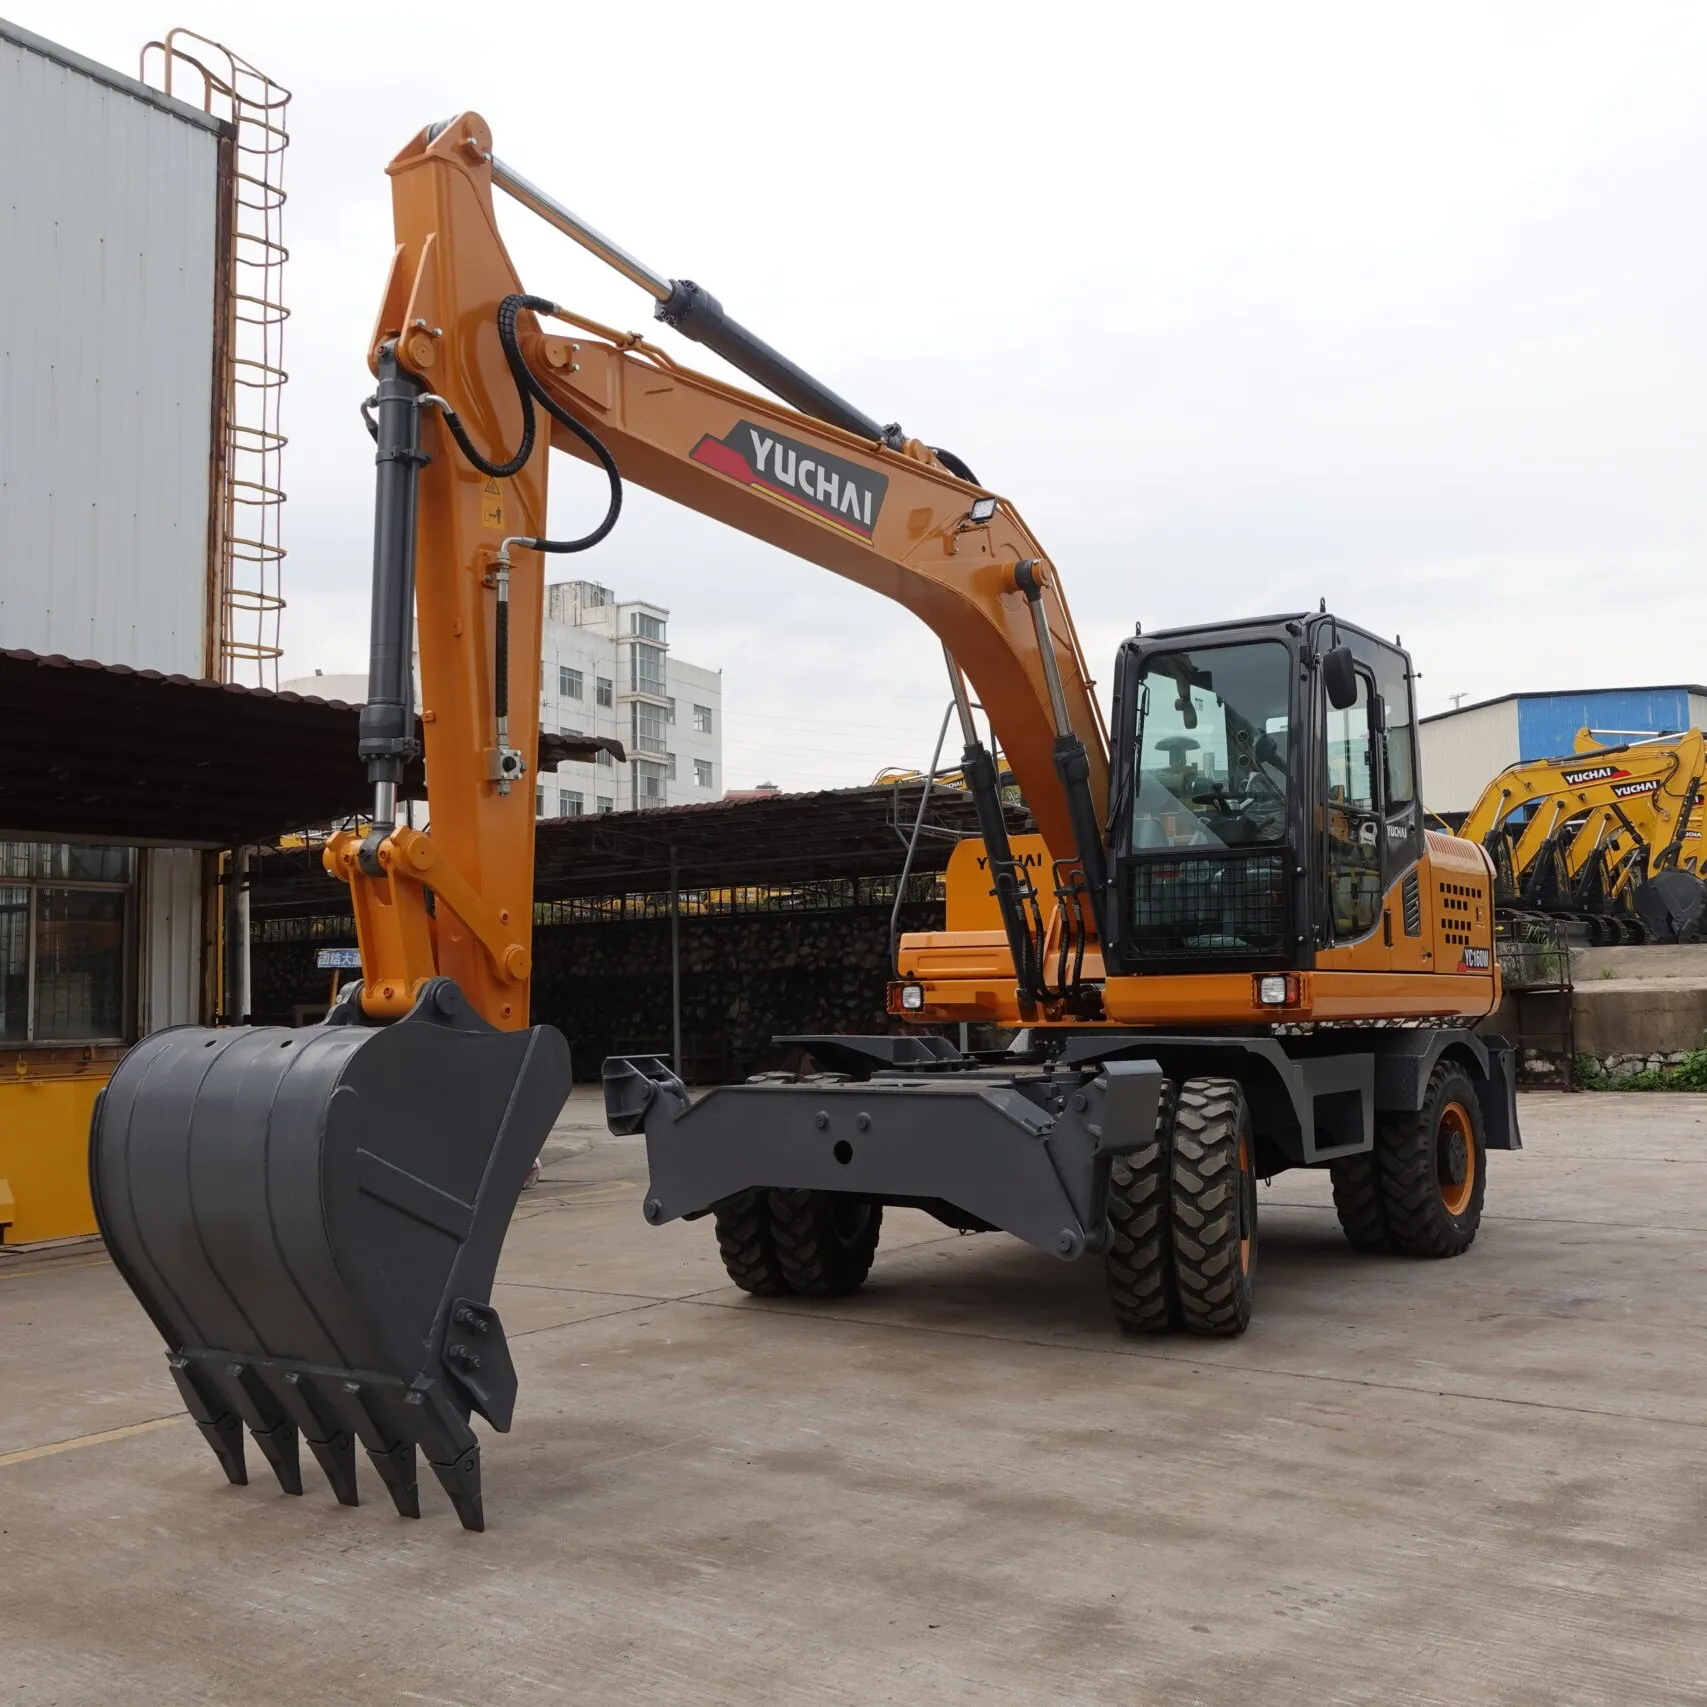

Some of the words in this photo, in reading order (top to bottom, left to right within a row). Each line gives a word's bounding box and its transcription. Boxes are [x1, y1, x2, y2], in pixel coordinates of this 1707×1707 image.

[750, 428, 872, 525] YUCHAI
[1566, 768, 1611, 783] YUCHAI
[1615, 781, 1657, 795] YUCHAI
[976, 853, 1042, 870] YHAI
[1464, 948, 1489, 967] YC160W
